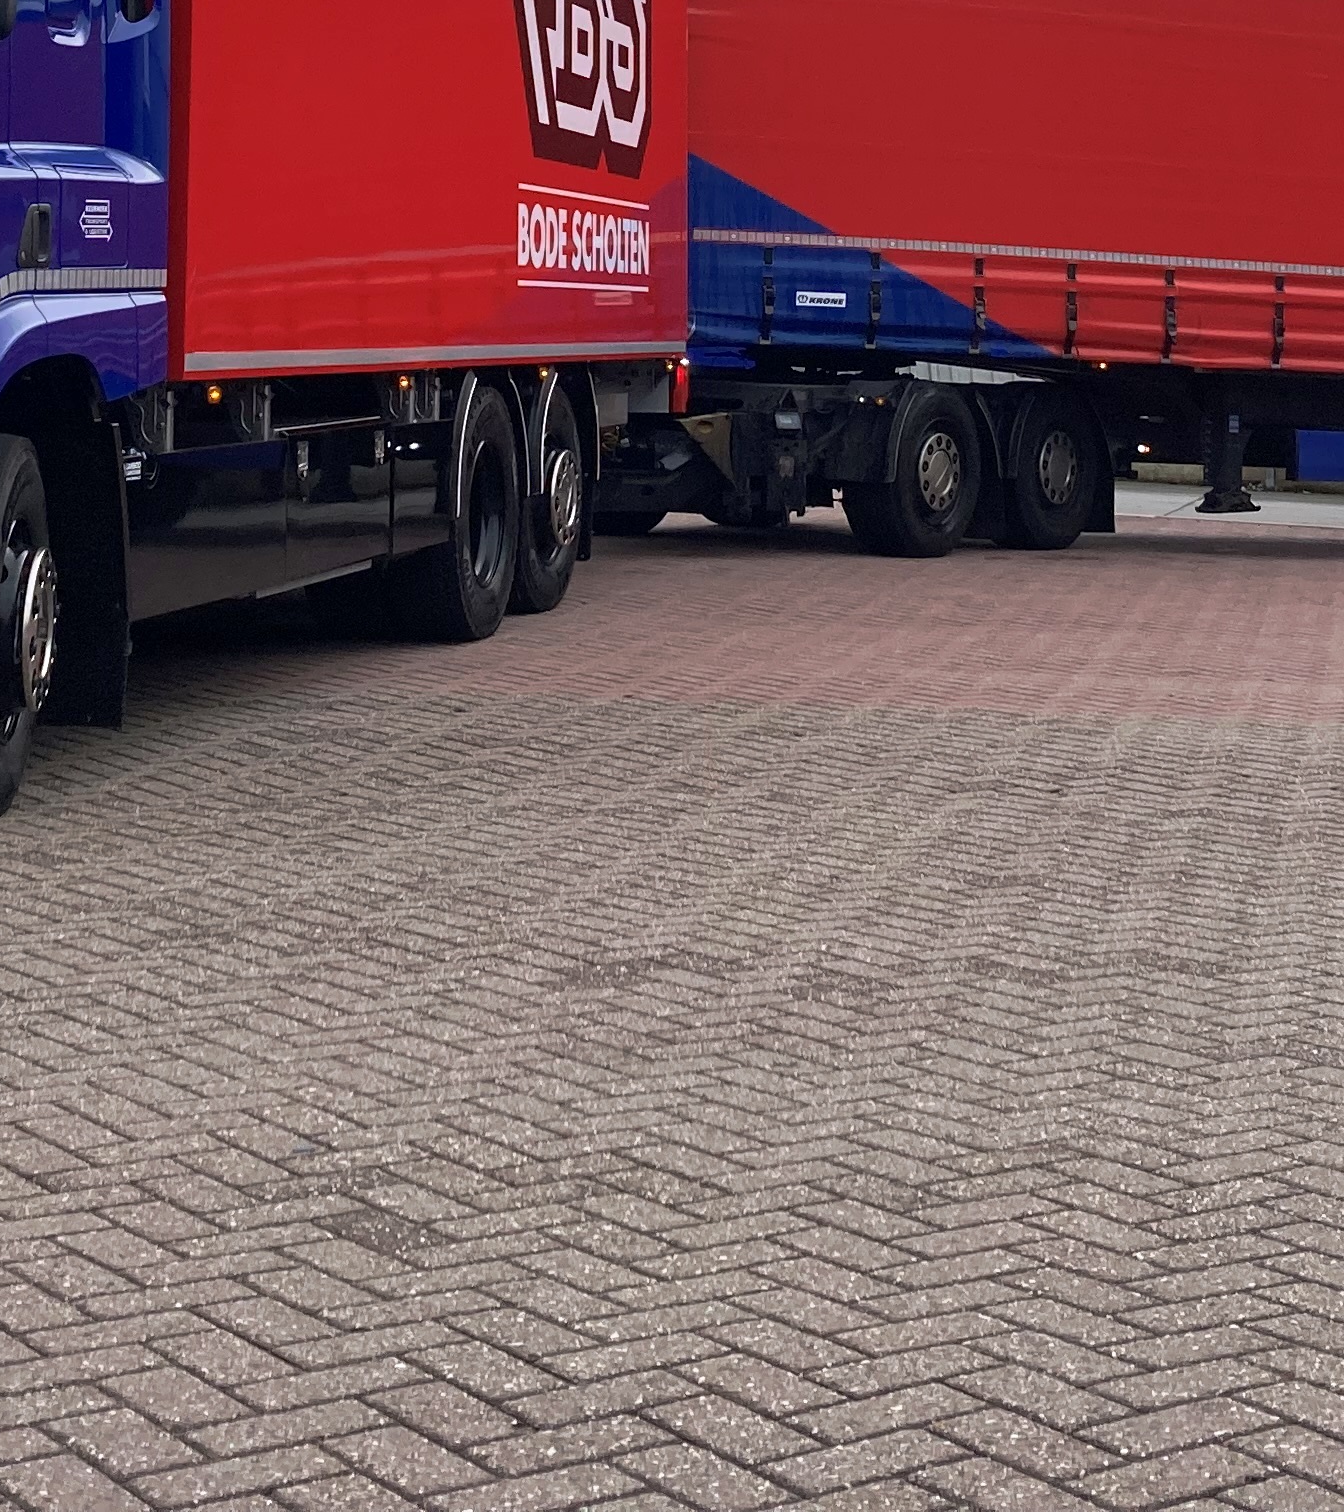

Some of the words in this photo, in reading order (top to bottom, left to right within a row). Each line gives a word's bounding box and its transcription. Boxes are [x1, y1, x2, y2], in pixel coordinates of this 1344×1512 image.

[517, 202, 568, 272] BODE
[571, 208, 650, 277] SCHOLTEN
[808, 297, 845, 306] KRONE
